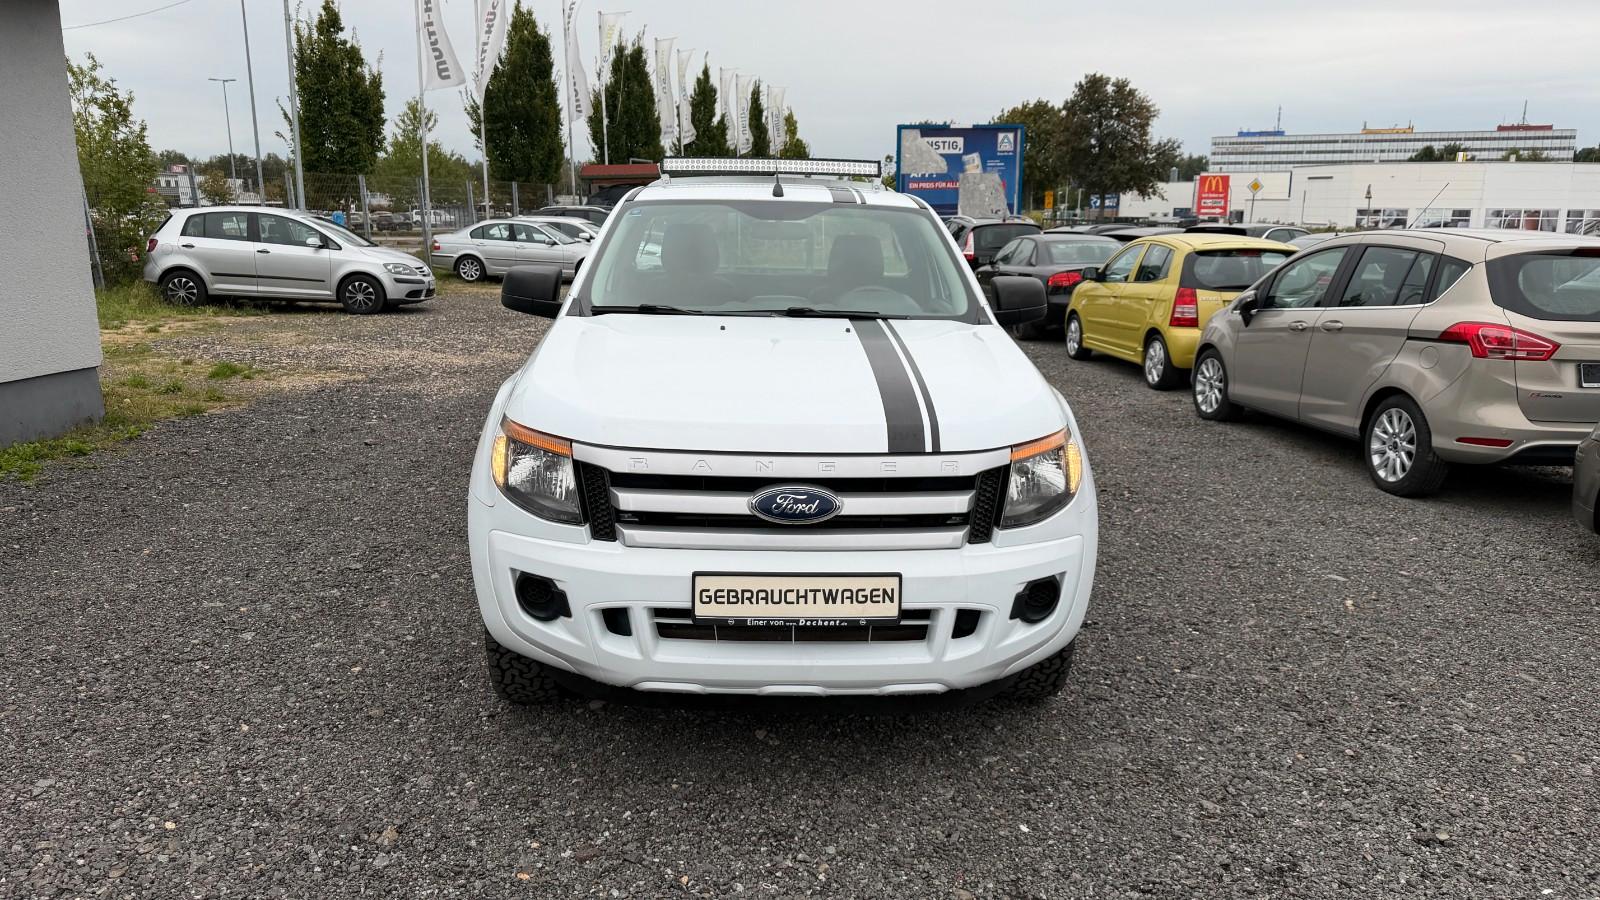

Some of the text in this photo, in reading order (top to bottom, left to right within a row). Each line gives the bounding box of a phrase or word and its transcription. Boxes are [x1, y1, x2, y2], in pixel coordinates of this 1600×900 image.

[627, 456, 961, 474] RANGER
[771, 493, 820, 514] Ford
[699, 587, 895, 605] GEBRAUCHTWAGEN
[747, 618, 766, 626] Einer
